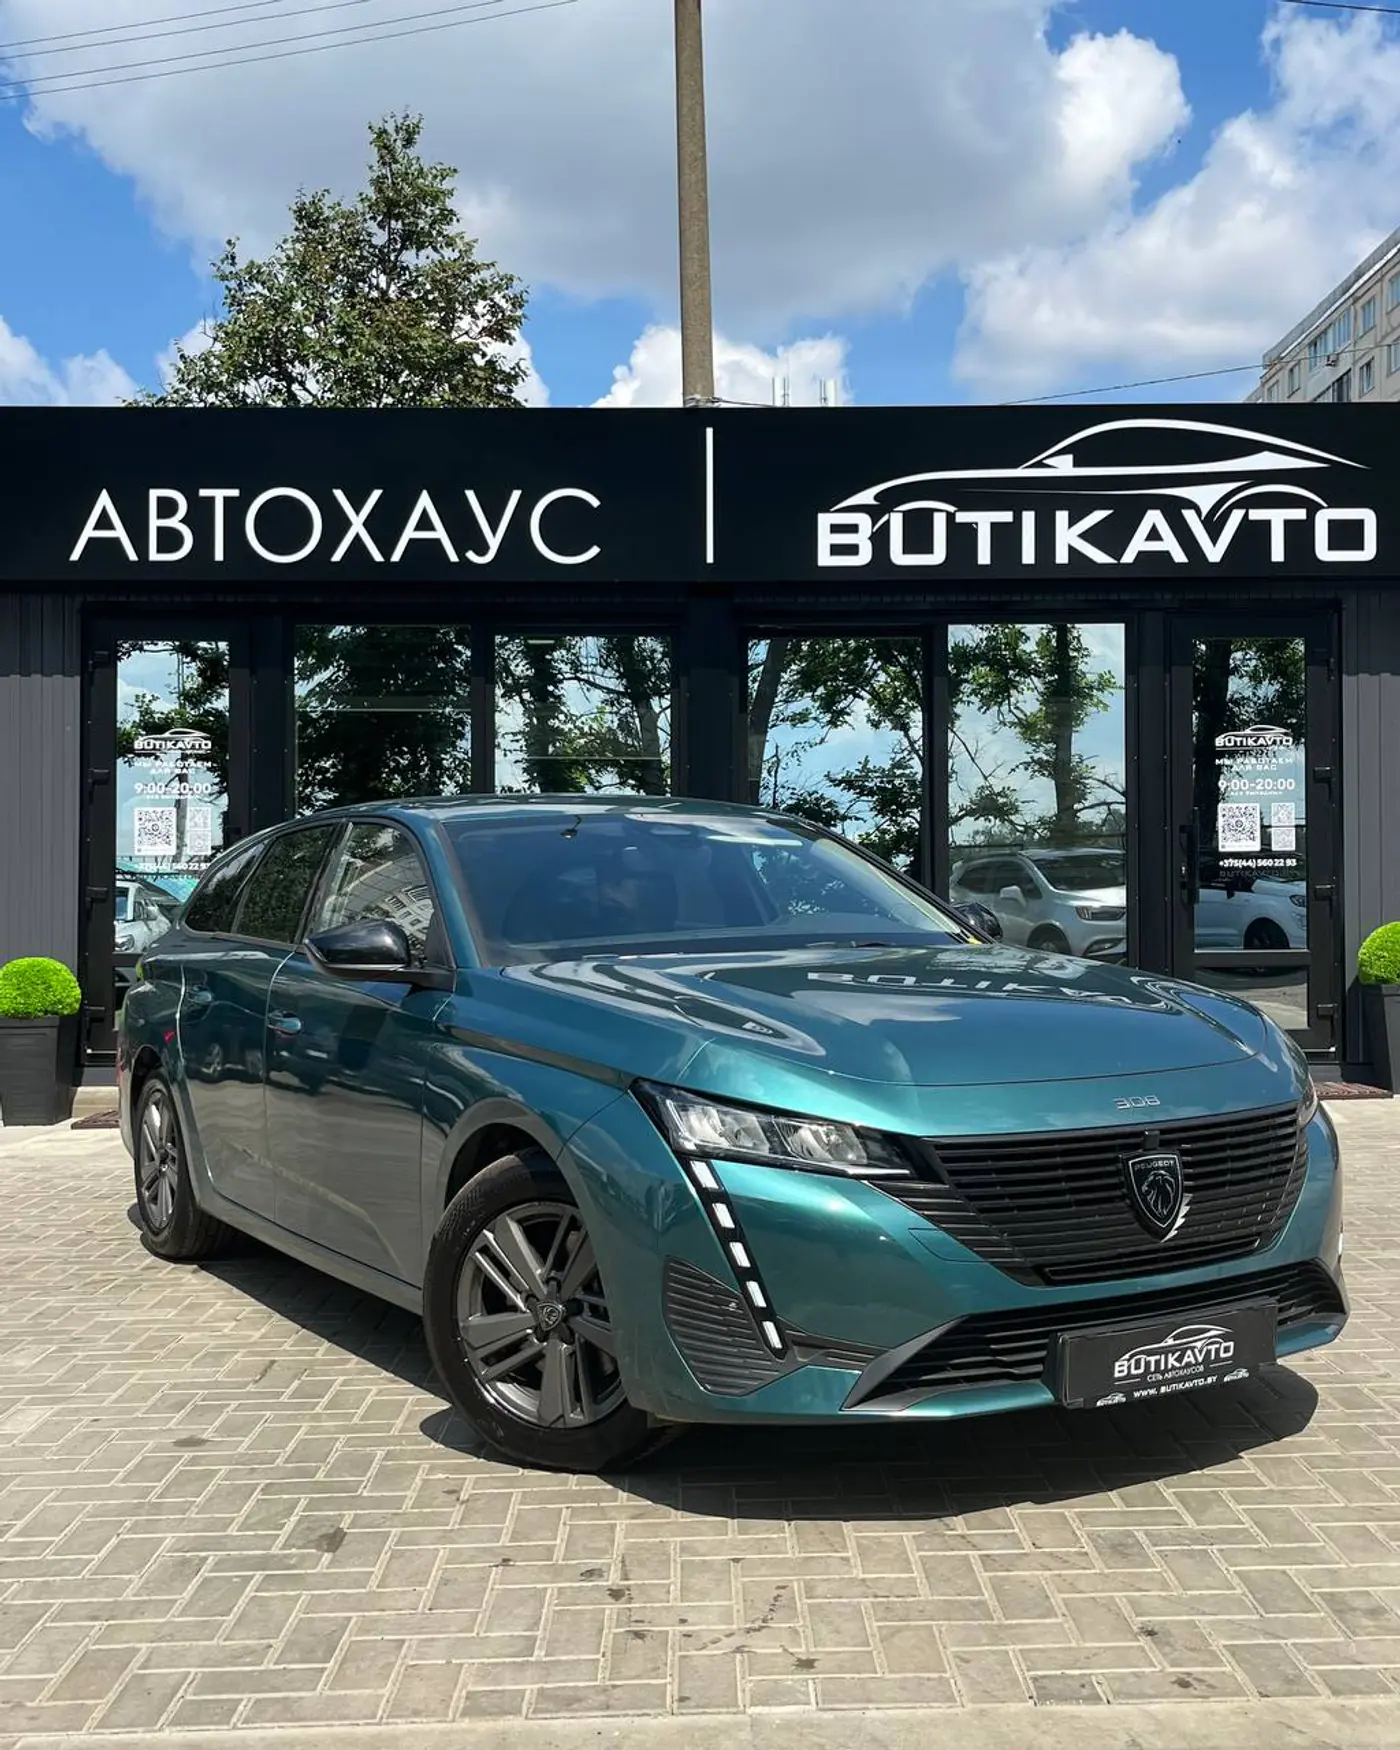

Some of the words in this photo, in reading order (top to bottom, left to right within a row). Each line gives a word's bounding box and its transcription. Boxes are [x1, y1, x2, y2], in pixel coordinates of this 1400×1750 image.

[69, 486, 602, 565] АВТОХАУС
[817, 506, 1378, 567] BUTIKAVTO
[134, 740, 212, 750] BUTIKAVTO
[1215, 736, 1293, 747] BUTIKAVTO
[134, 782, 212, 794] 9:00-20:00
[1218, 778, 1296, 791] 9:00-20:00
[1257, 858, 1274, 867] 560
[1274, 858, 1285, 867] 22
[1285, 858, 1297, 867] 93
[1114, 1094, 1161, 1109] 308
[1134, 1159, 1175, 1171] PEUGEOT
[1114, 1341, 1235, 1378] BUTIKAVTO
[1163, 1364, 1205, 1379] АВТОХАУСОВ
